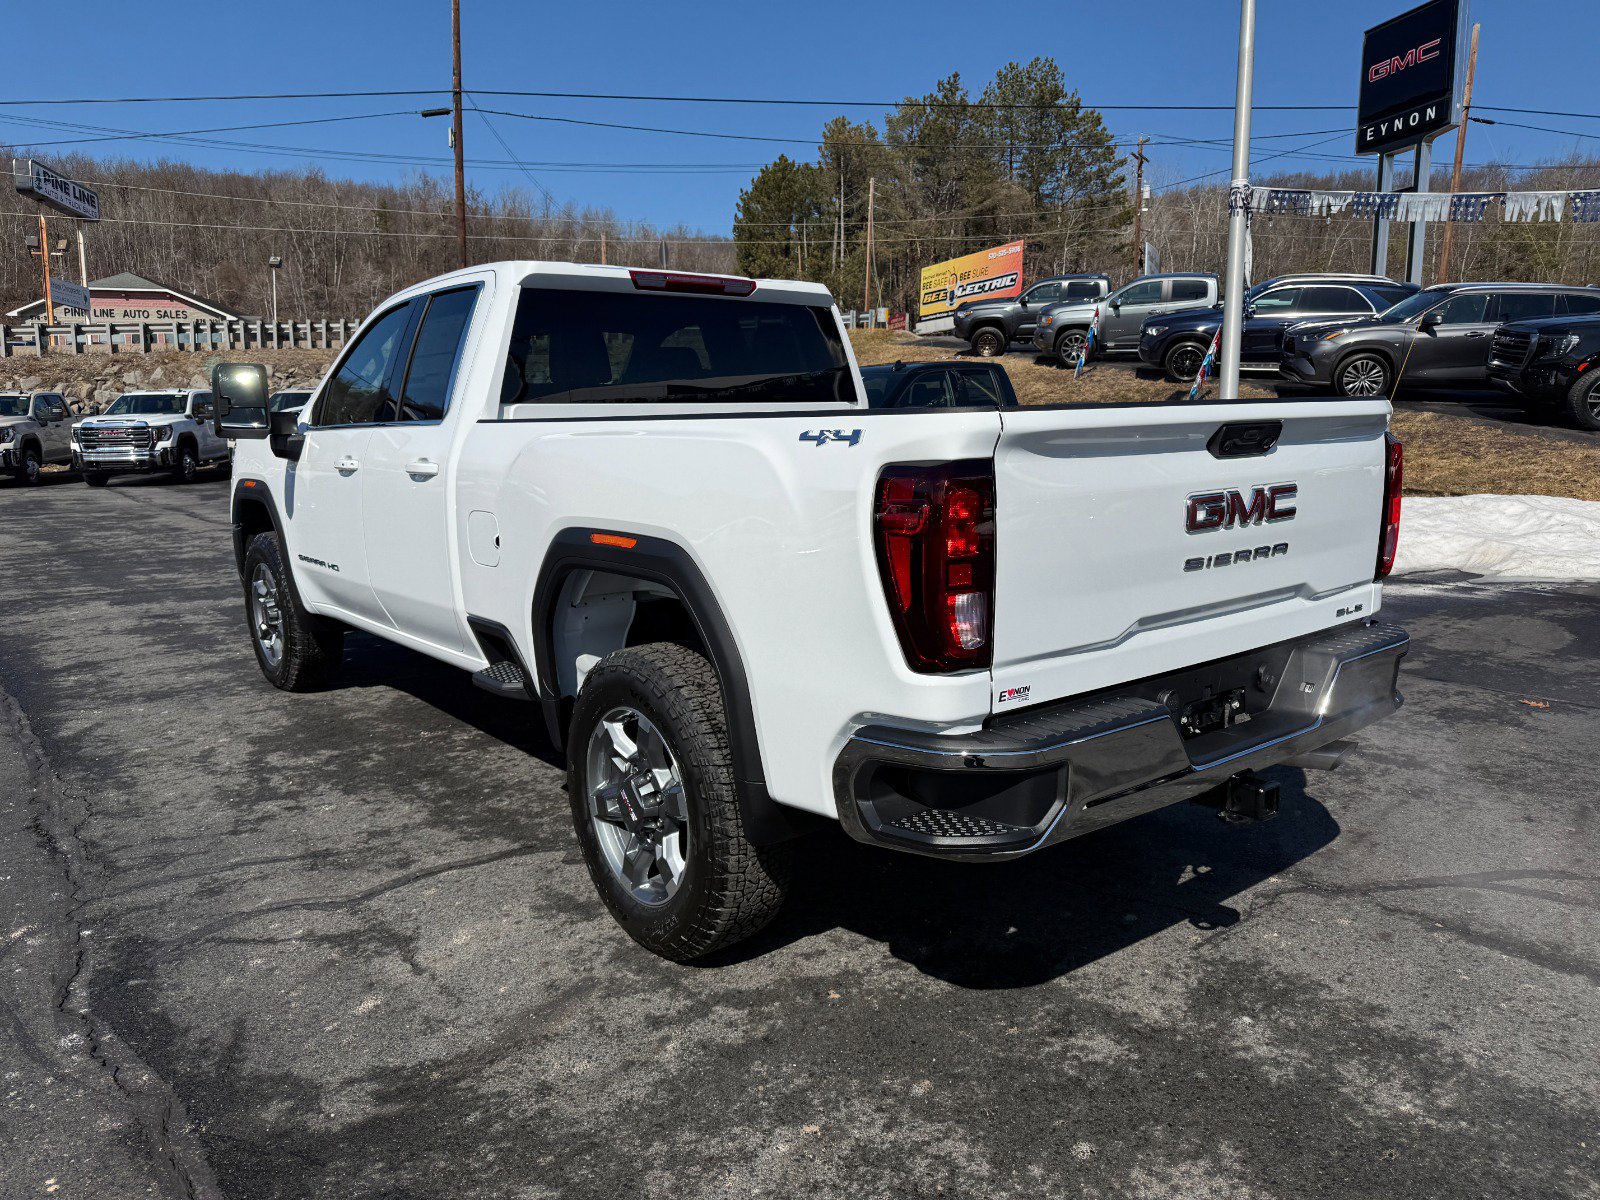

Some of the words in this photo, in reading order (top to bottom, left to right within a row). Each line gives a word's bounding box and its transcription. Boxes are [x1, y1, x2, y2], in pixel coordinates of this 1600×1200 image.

[1369, 38, 1441, 82] GMC
[1367, 106, 1436, 141] EYNON
[42, 170, 71, 197] PINE
[72, 185, 97, 209] LINE
[922, 280, 933, 290] BEE
[933, 277, 948, 288] SAFE
[959, 270, 971, 281] BEE
[973, 267, 989, 279] SURE
[922, 290, 948, 304] BEE
[93, 308, 115, 318] LINE
[122, 309, 150, 319] AUTO
[156, 309, 188, 319] SALES
[1184, 481, 1298, 535] GMC
[298, 554, 327, 568] SIERRA
[327, 562, 340, 572] HD
[1183, 542, 1289, 573] SIERRA
[1335, 603, 1363, 618] SLE
